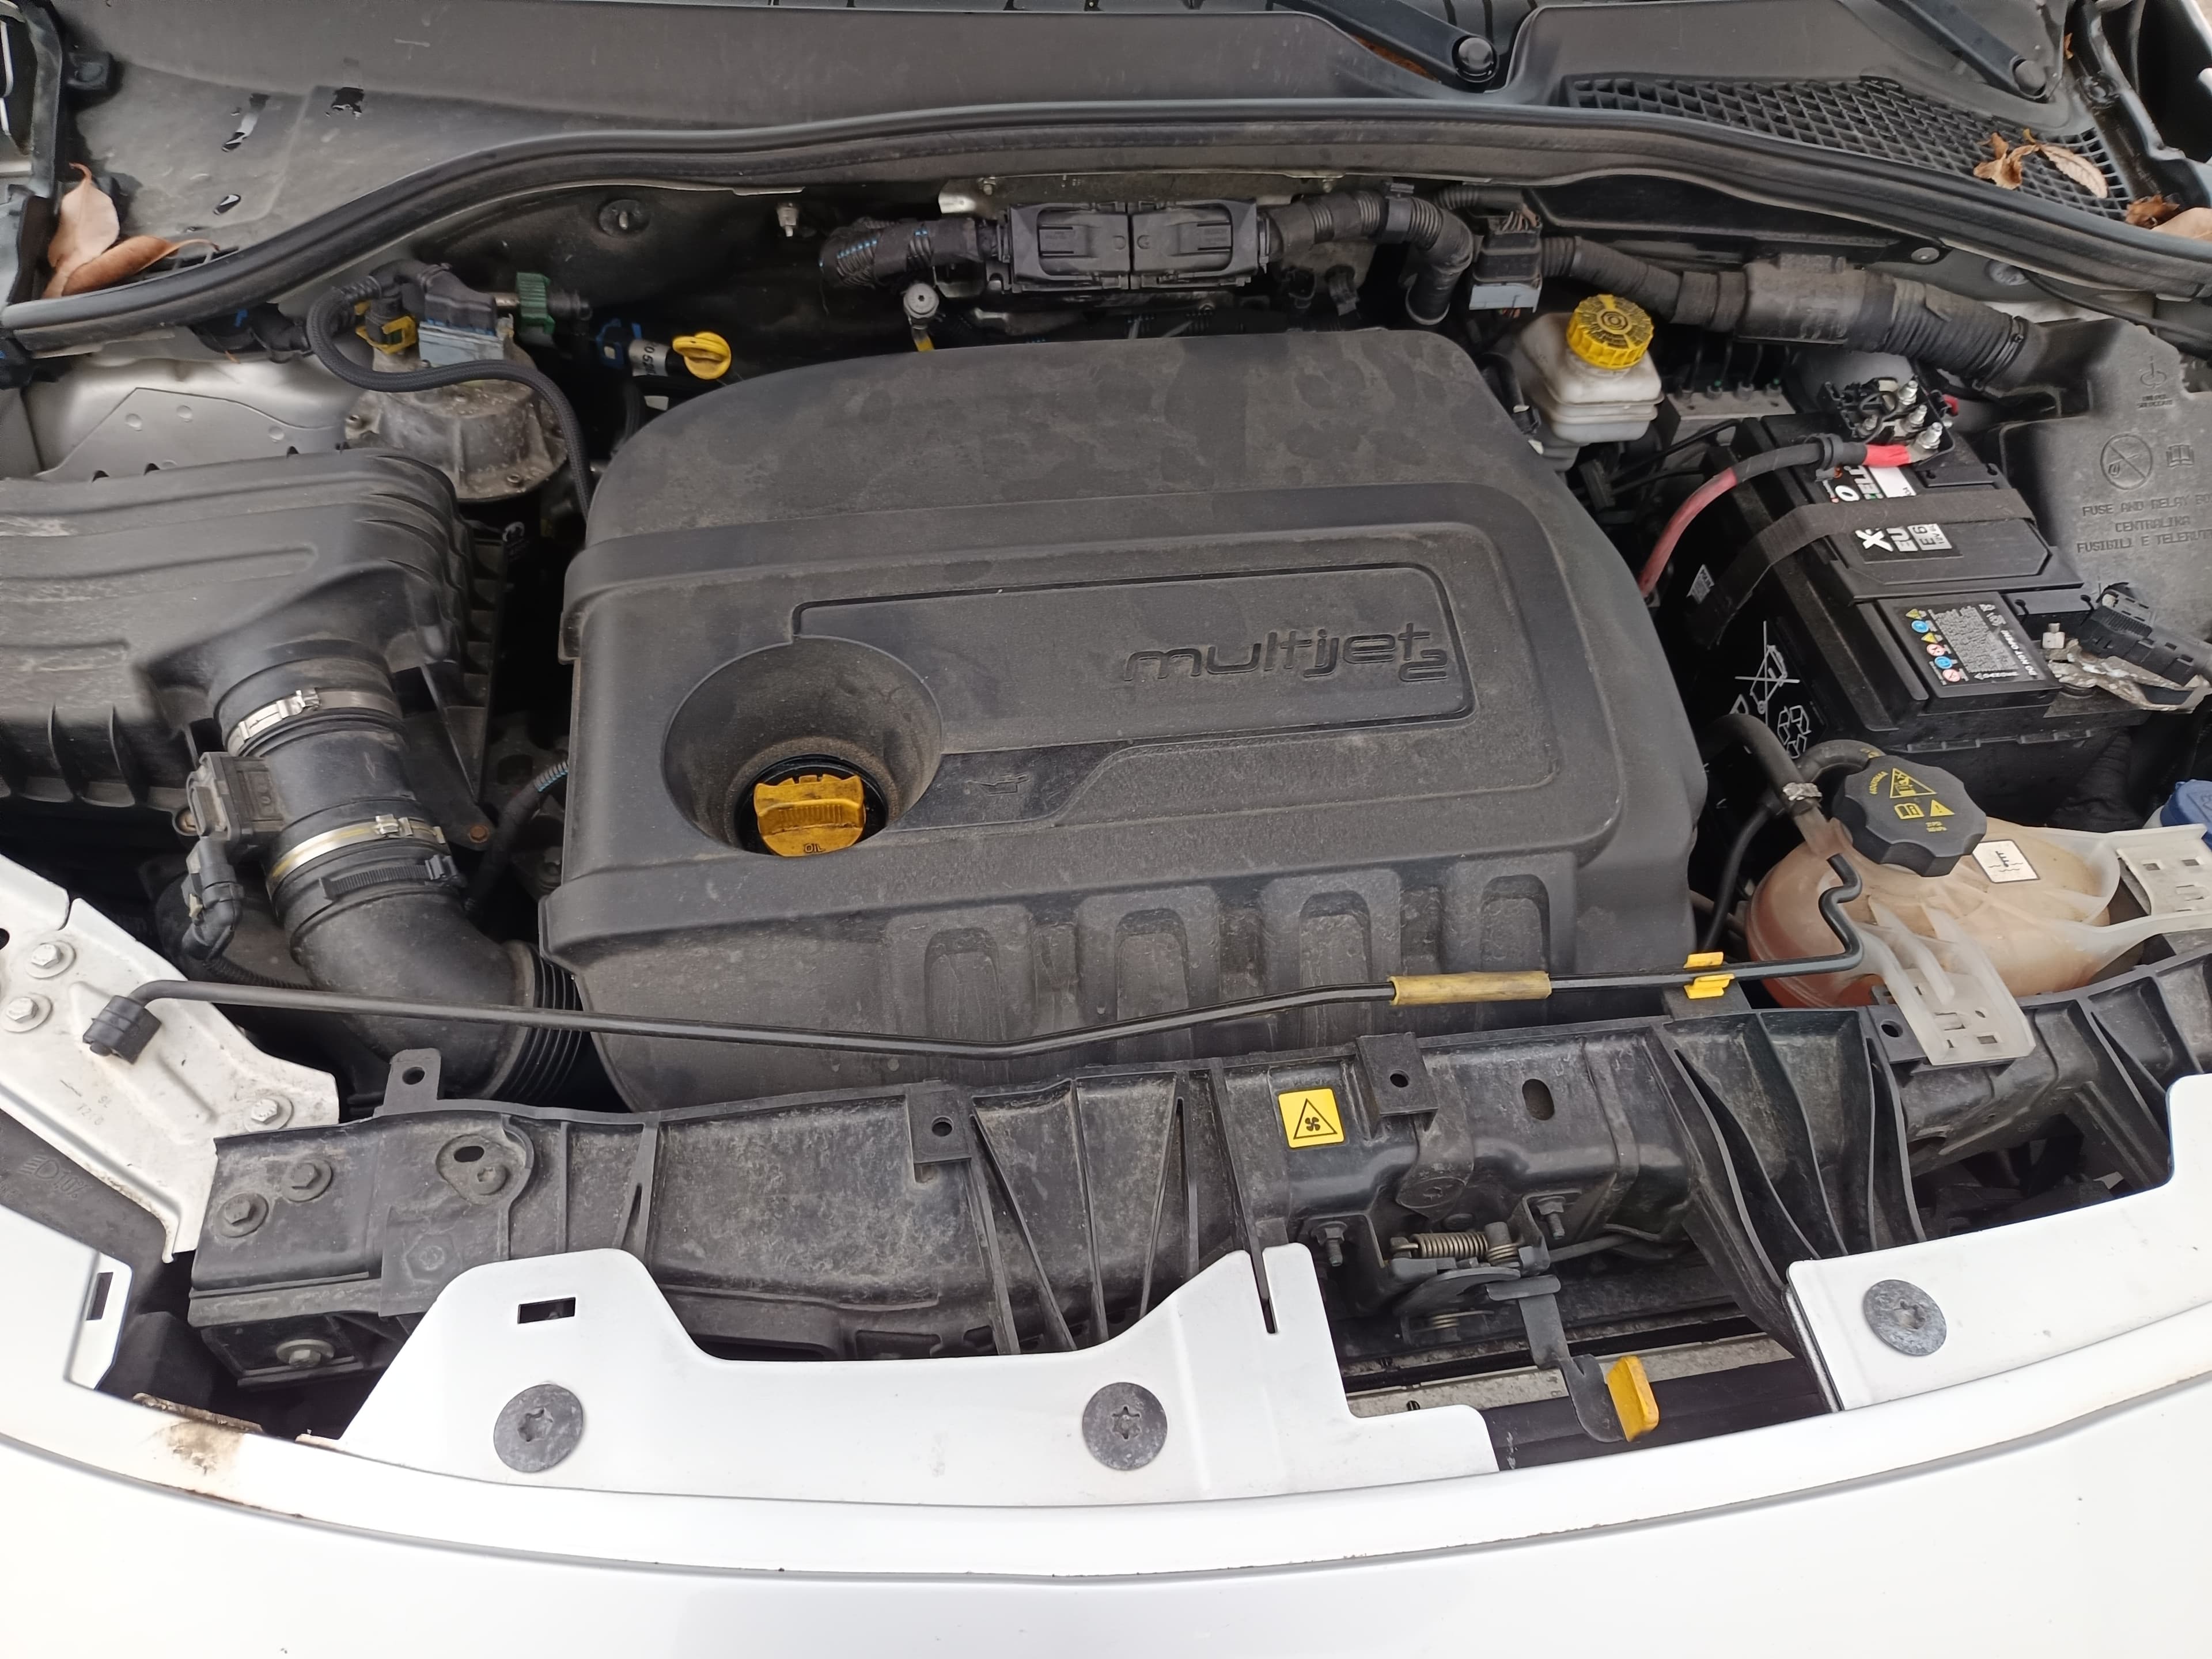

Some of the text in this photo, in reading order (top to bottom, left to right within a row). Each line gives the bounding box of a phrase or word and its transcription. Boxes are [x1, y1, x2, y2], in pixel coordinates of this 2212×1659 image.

[2082, 504, 2114, 517] FUSE
[1124, 622, 1431, 682] multijet
[803, 843, 826, 853] OIL
